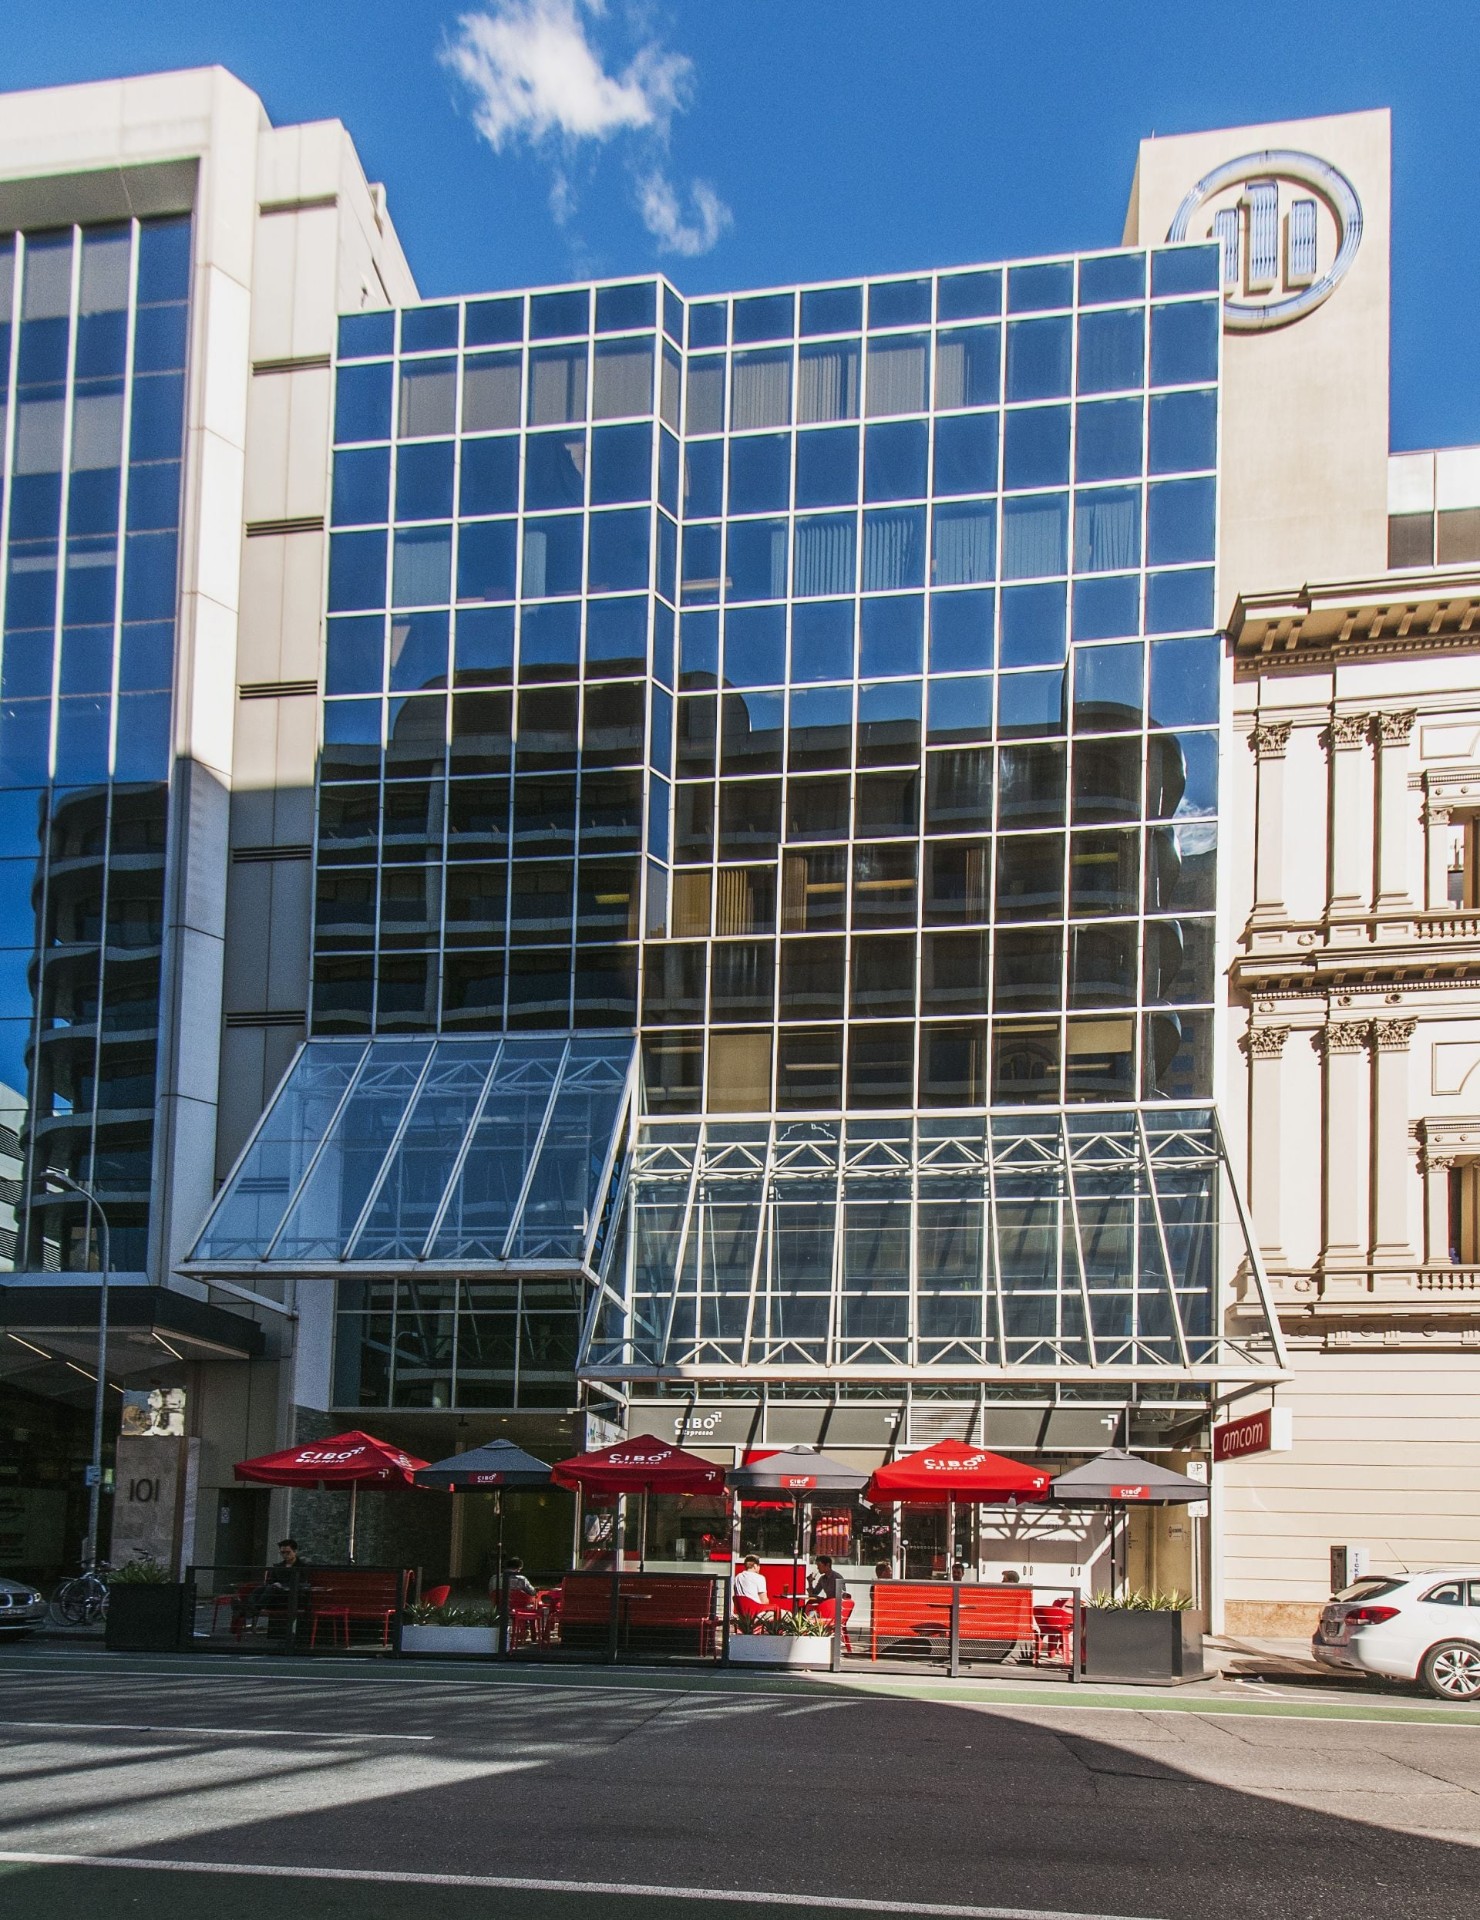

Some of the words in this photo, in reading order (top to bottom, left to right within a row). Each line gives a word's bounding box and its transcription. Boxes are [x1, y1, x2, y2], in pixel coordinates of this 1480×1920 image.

[674, 1417, 715, 1429] CIBO
[1222, 1422, 1263, 1453] amcom
[300, 1451, 353, 1460] CIBO
[609, 1453, 662, 1462] CIBO
[923, 1458, 978, 1468] CIBO
